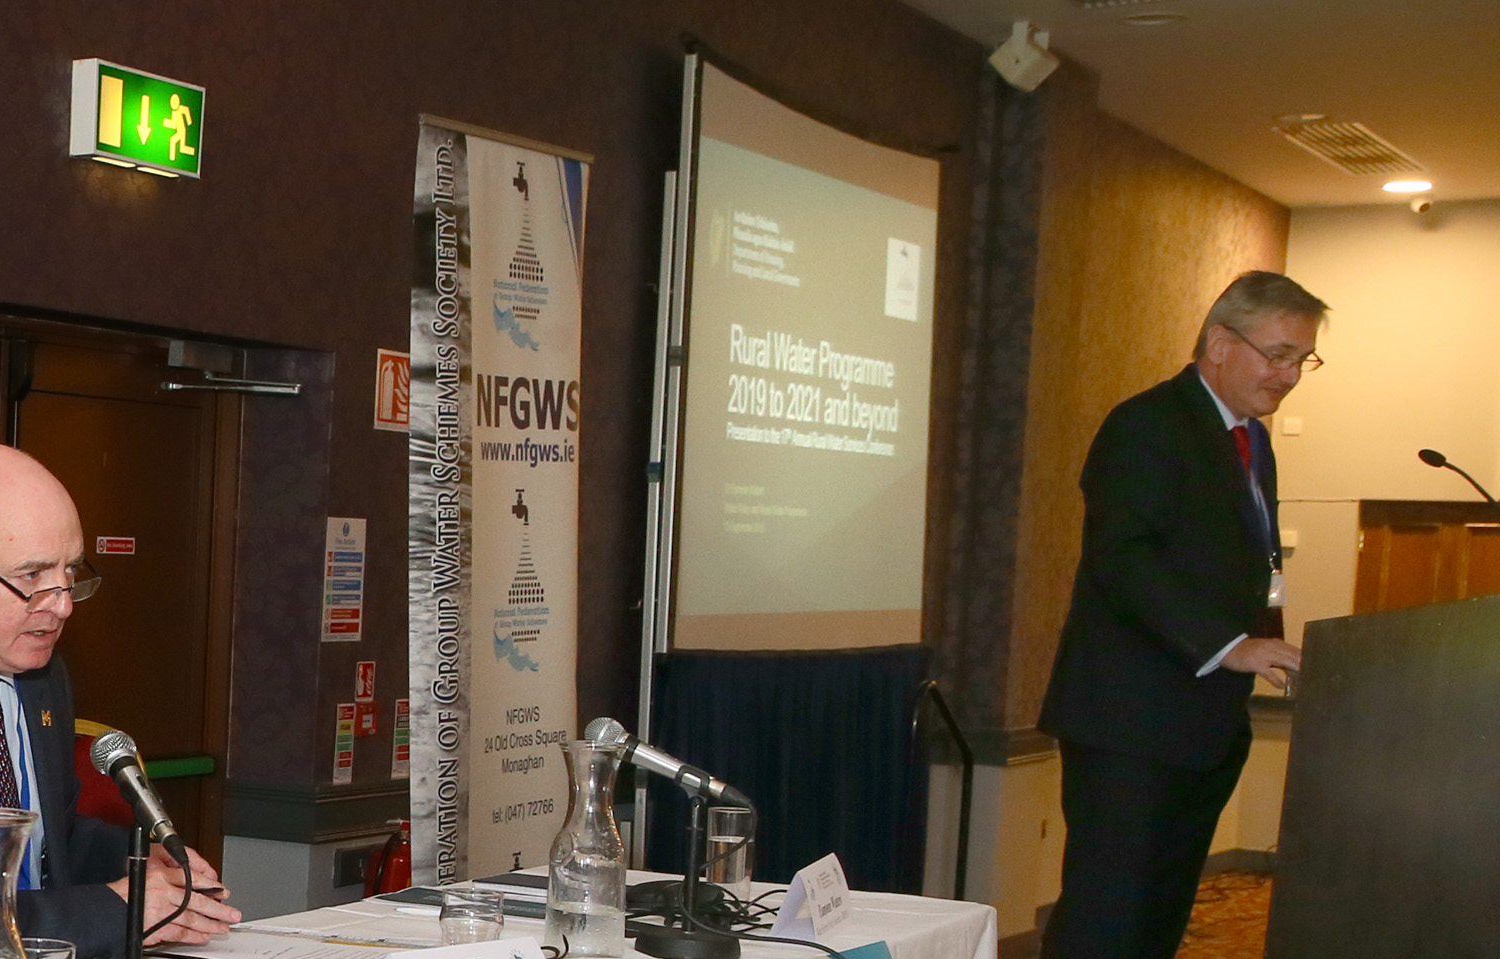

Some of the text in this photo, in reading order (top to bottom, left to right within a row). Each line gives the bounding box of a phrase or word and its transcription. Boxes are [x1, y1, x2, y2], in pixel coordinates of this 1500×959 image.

[431, 138, 456, 205] LTD.
[430, 208, 461, 339] SOCIETY
[729, 323, 895, 391] Rural Water Programme
[430, 343, 461, 482] SCHEMES
[477, 373, 580, 432] NFGWS
[727, 373, 899, 443] 2019 to 2021 and beyond
[480, 437, 575, 468] www.nfgws.ie
[430, 487, 461, 591] WATER
[431, 597, 461, 704] GROUP
[435, 709, 460, 750] OF
[494, 735, 508, 752] Old
[509, 732, 533, 750] Cross
[535, 729, 567, 748] Square
[506, 706, 540, 726] NFGWS
[501, 755, 545, 775] Monaghan
[505, 803, 526, 824] (047)
[528, 798, 554, 817] 72766
